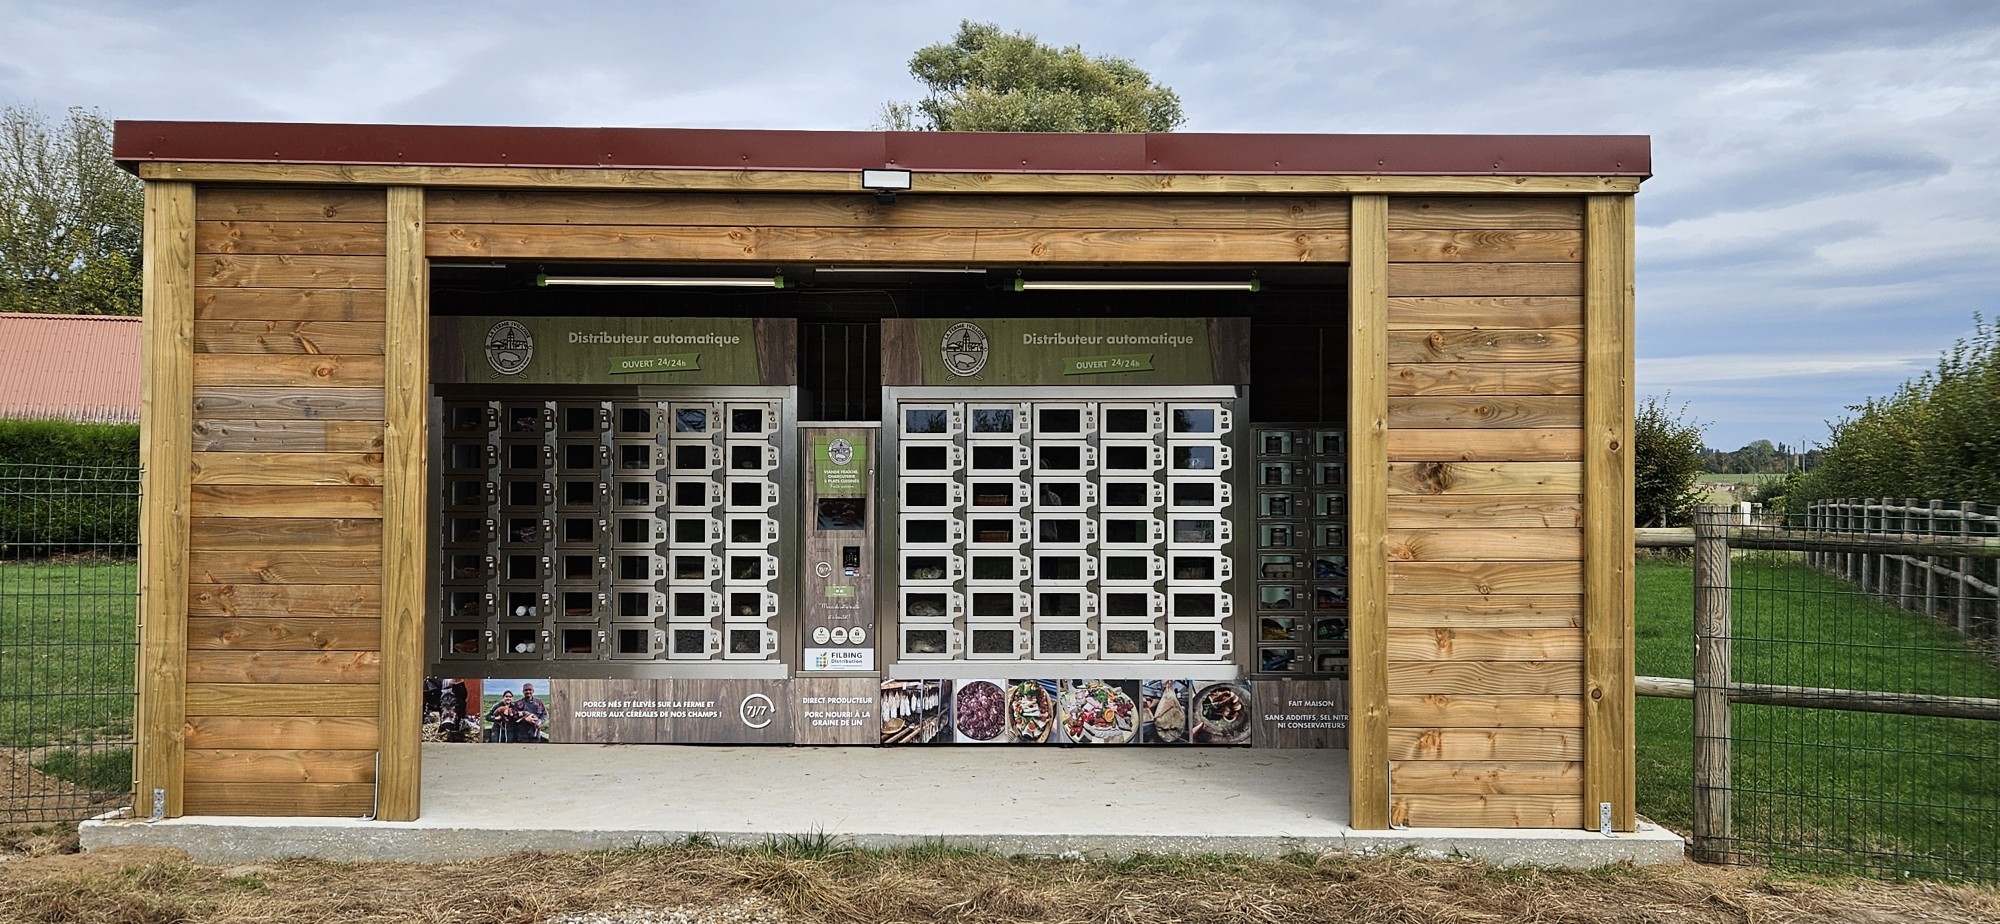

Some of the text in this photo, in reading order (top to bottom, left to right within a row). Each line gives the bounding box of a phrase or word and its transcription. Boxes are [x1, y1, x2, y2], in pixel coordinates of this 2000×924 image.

[568, 332, 740, 347] Distributeur automatique
[1023, 333, 1194, 347] Distributeur automatique
[622, 358, 686, 368] OUVERT 24/24h
[1076, 358, 1140, 369] OUVERT 24/24h
[746, 706, 767, 718] 7J/7
